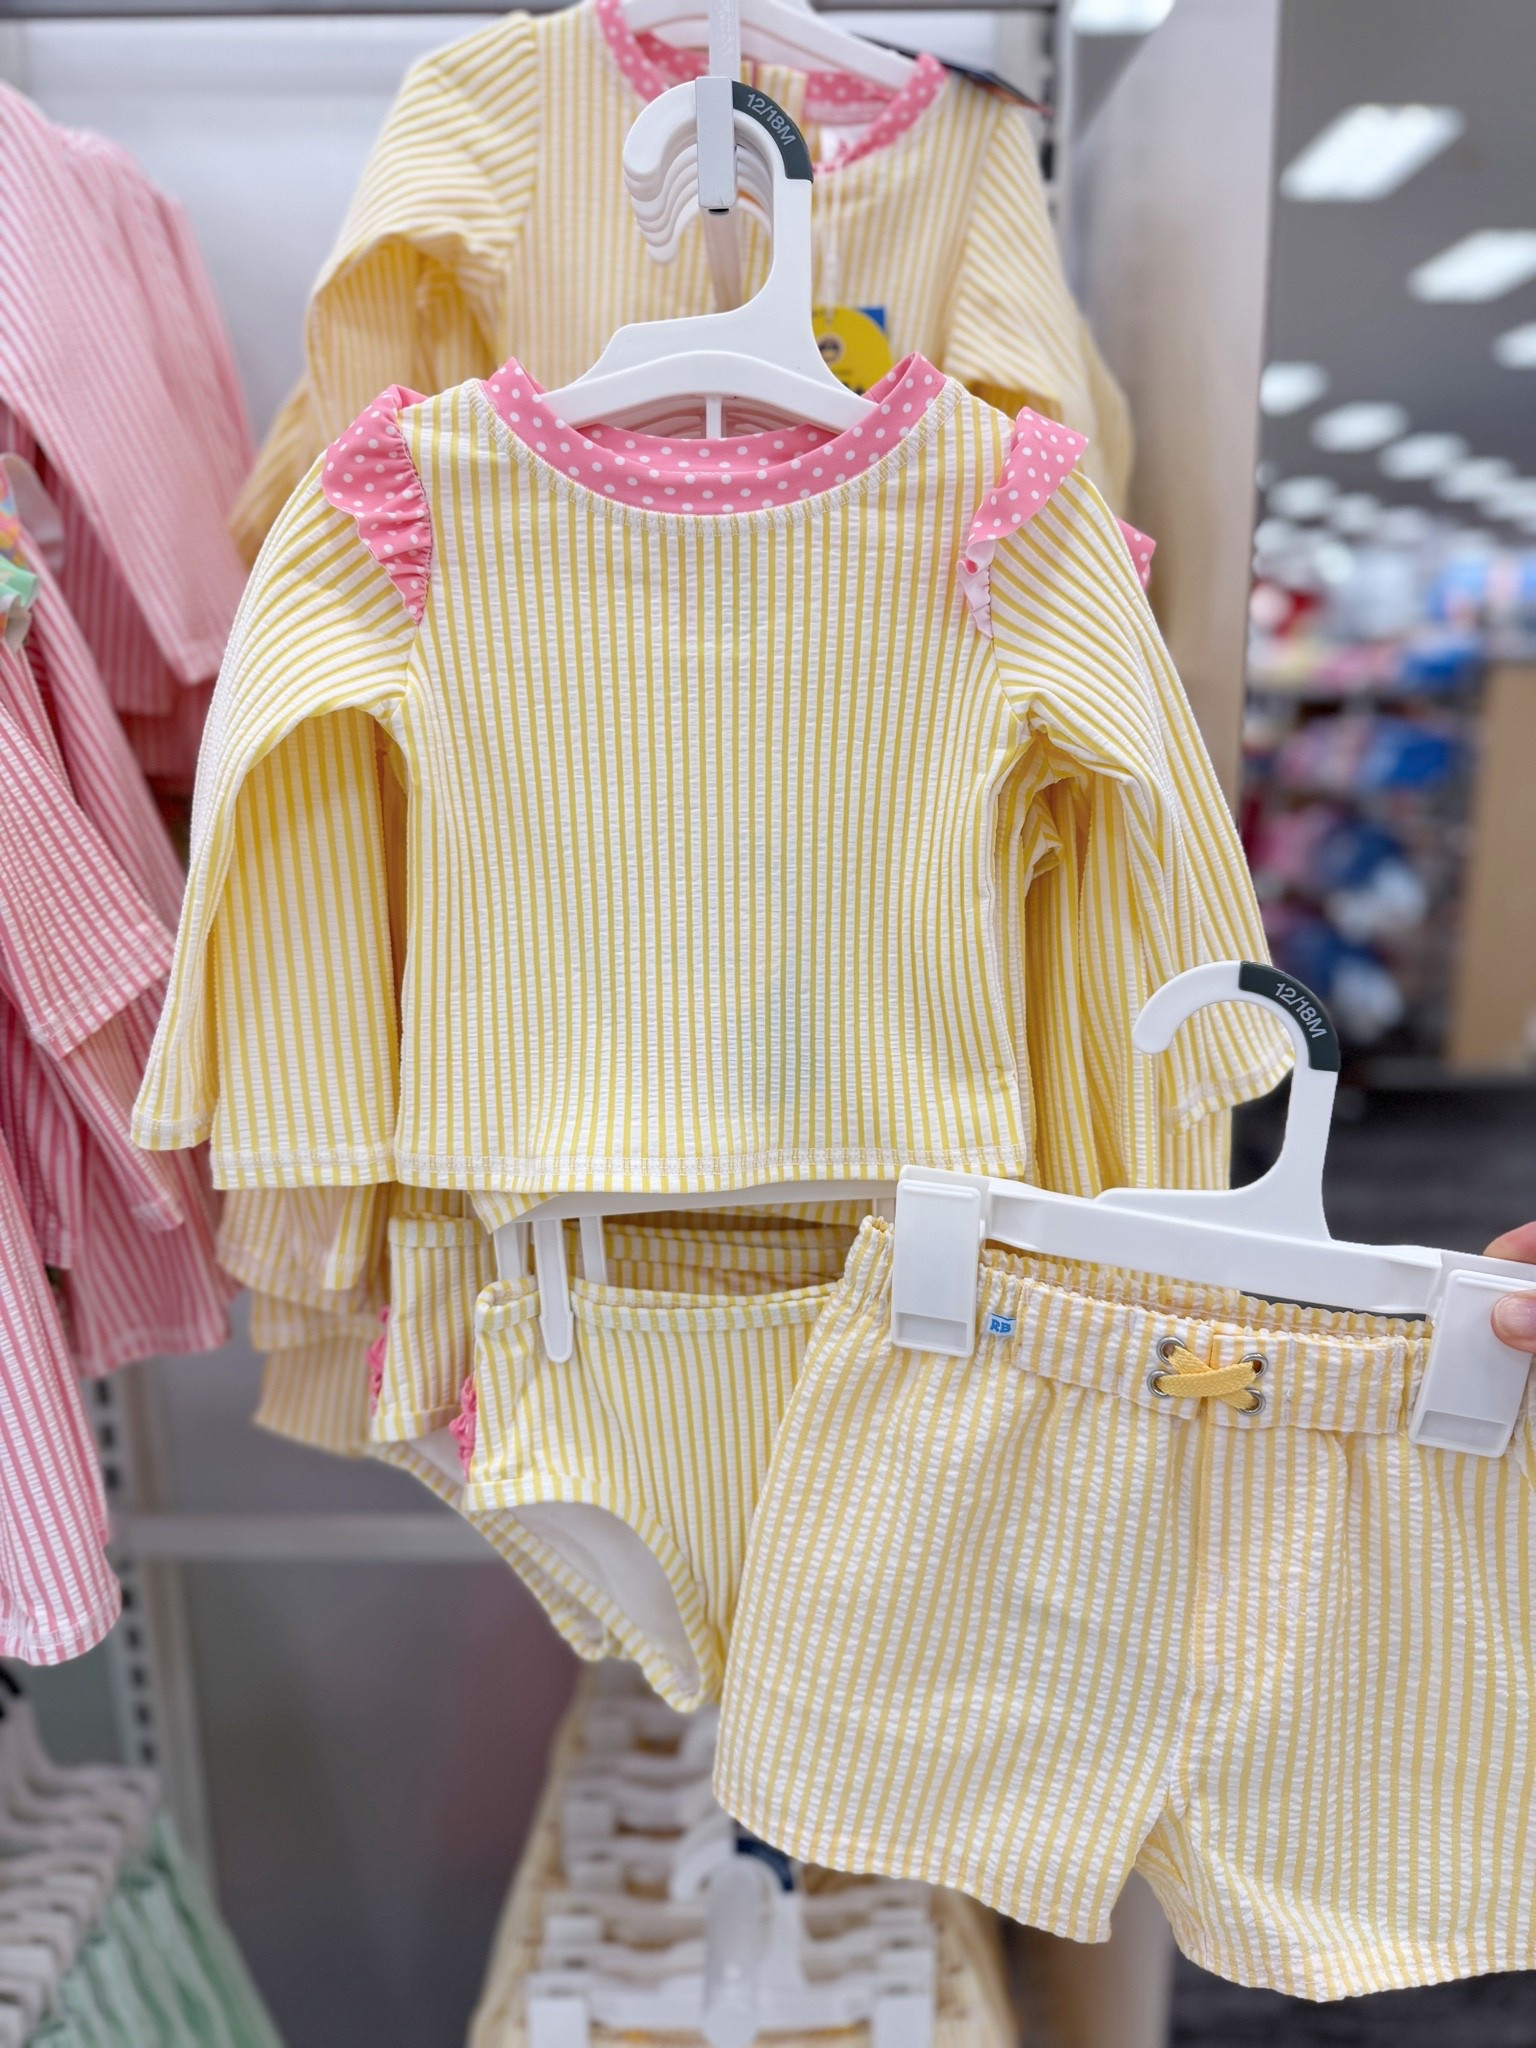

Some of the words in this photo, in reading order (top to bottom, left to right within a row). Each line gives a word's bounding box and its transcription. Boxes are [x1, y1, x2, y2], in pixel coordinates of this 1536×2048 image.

[747, 93, 797, 146] 12/18M
[1275, 982, 1328, 1039] 12/18M
[990, 1318, 1011, 1333] RB
